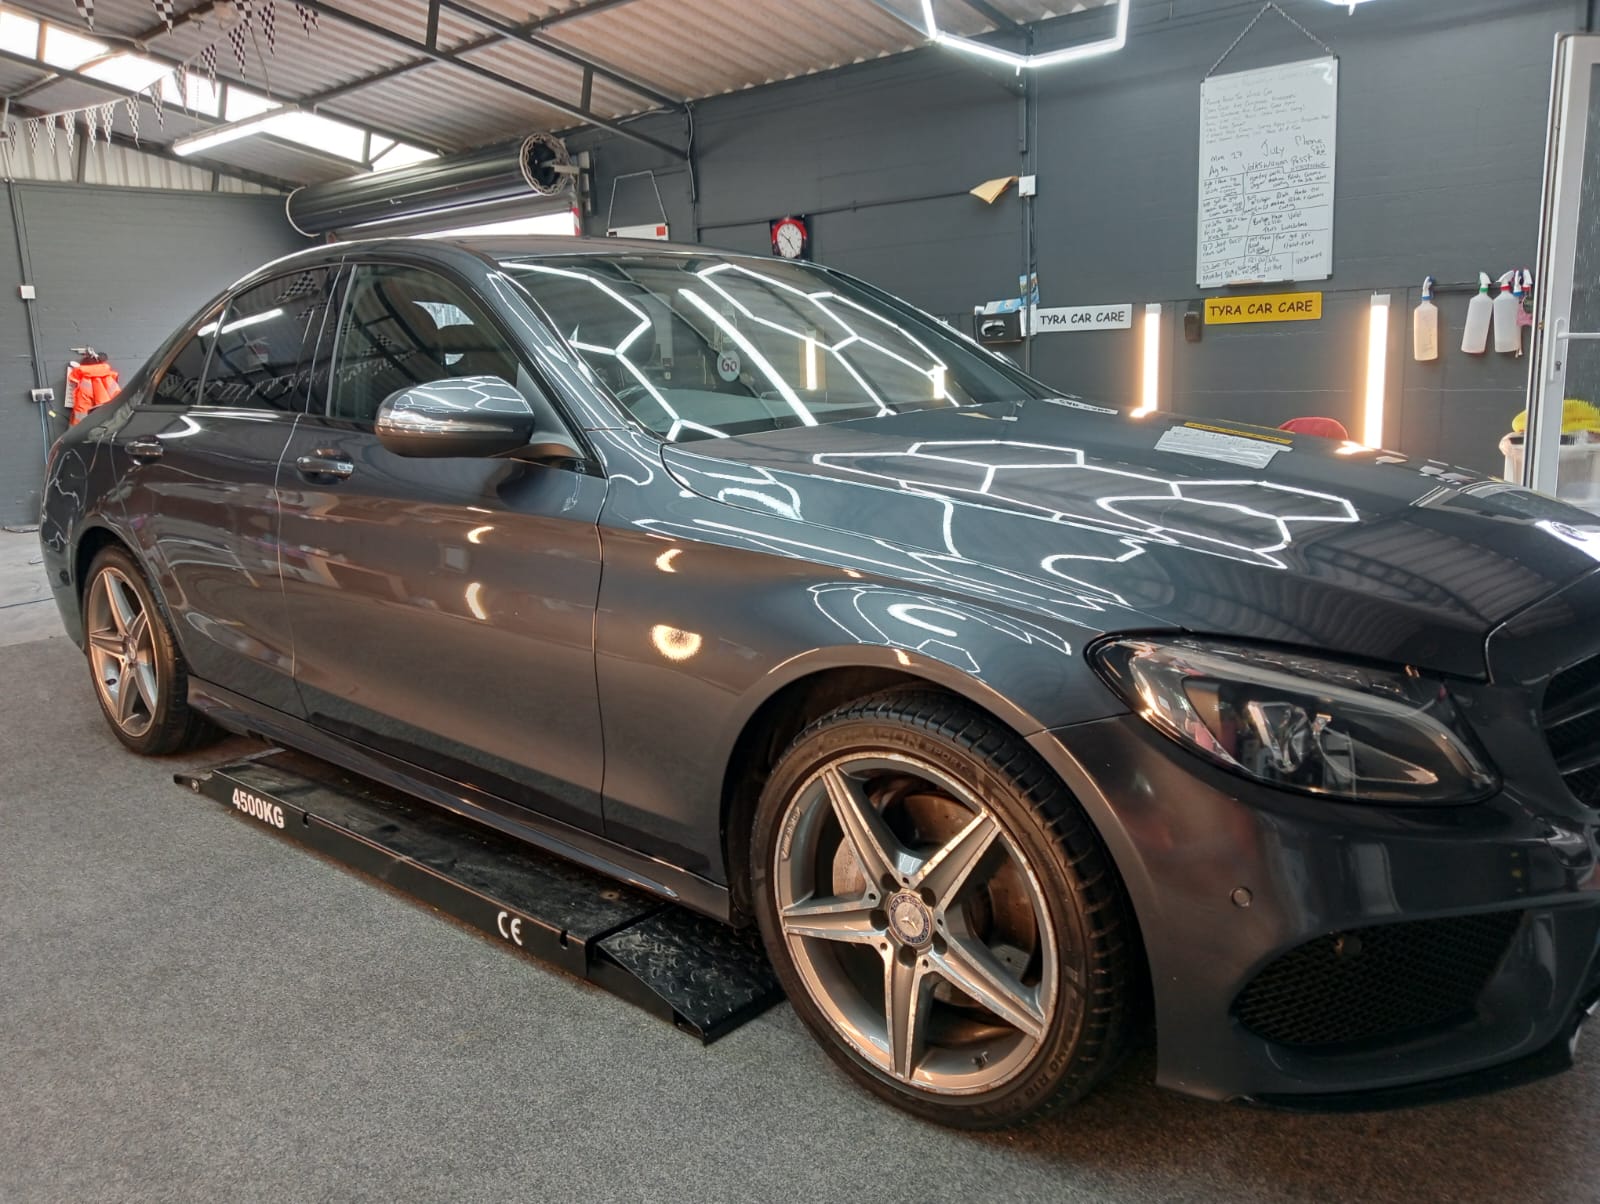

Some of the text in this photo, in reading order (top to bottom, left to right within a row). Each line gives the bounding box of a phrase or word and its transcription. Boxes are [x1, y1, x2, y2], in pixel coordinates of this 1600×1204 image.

[1040, 311, 1126, 326] TYRA CAR CARE
[1210, 300, 1313, 317] TYRA CAR CARE
[232, 787, 285, 829] 4500KG
[497, 911, 523, 946] CE
